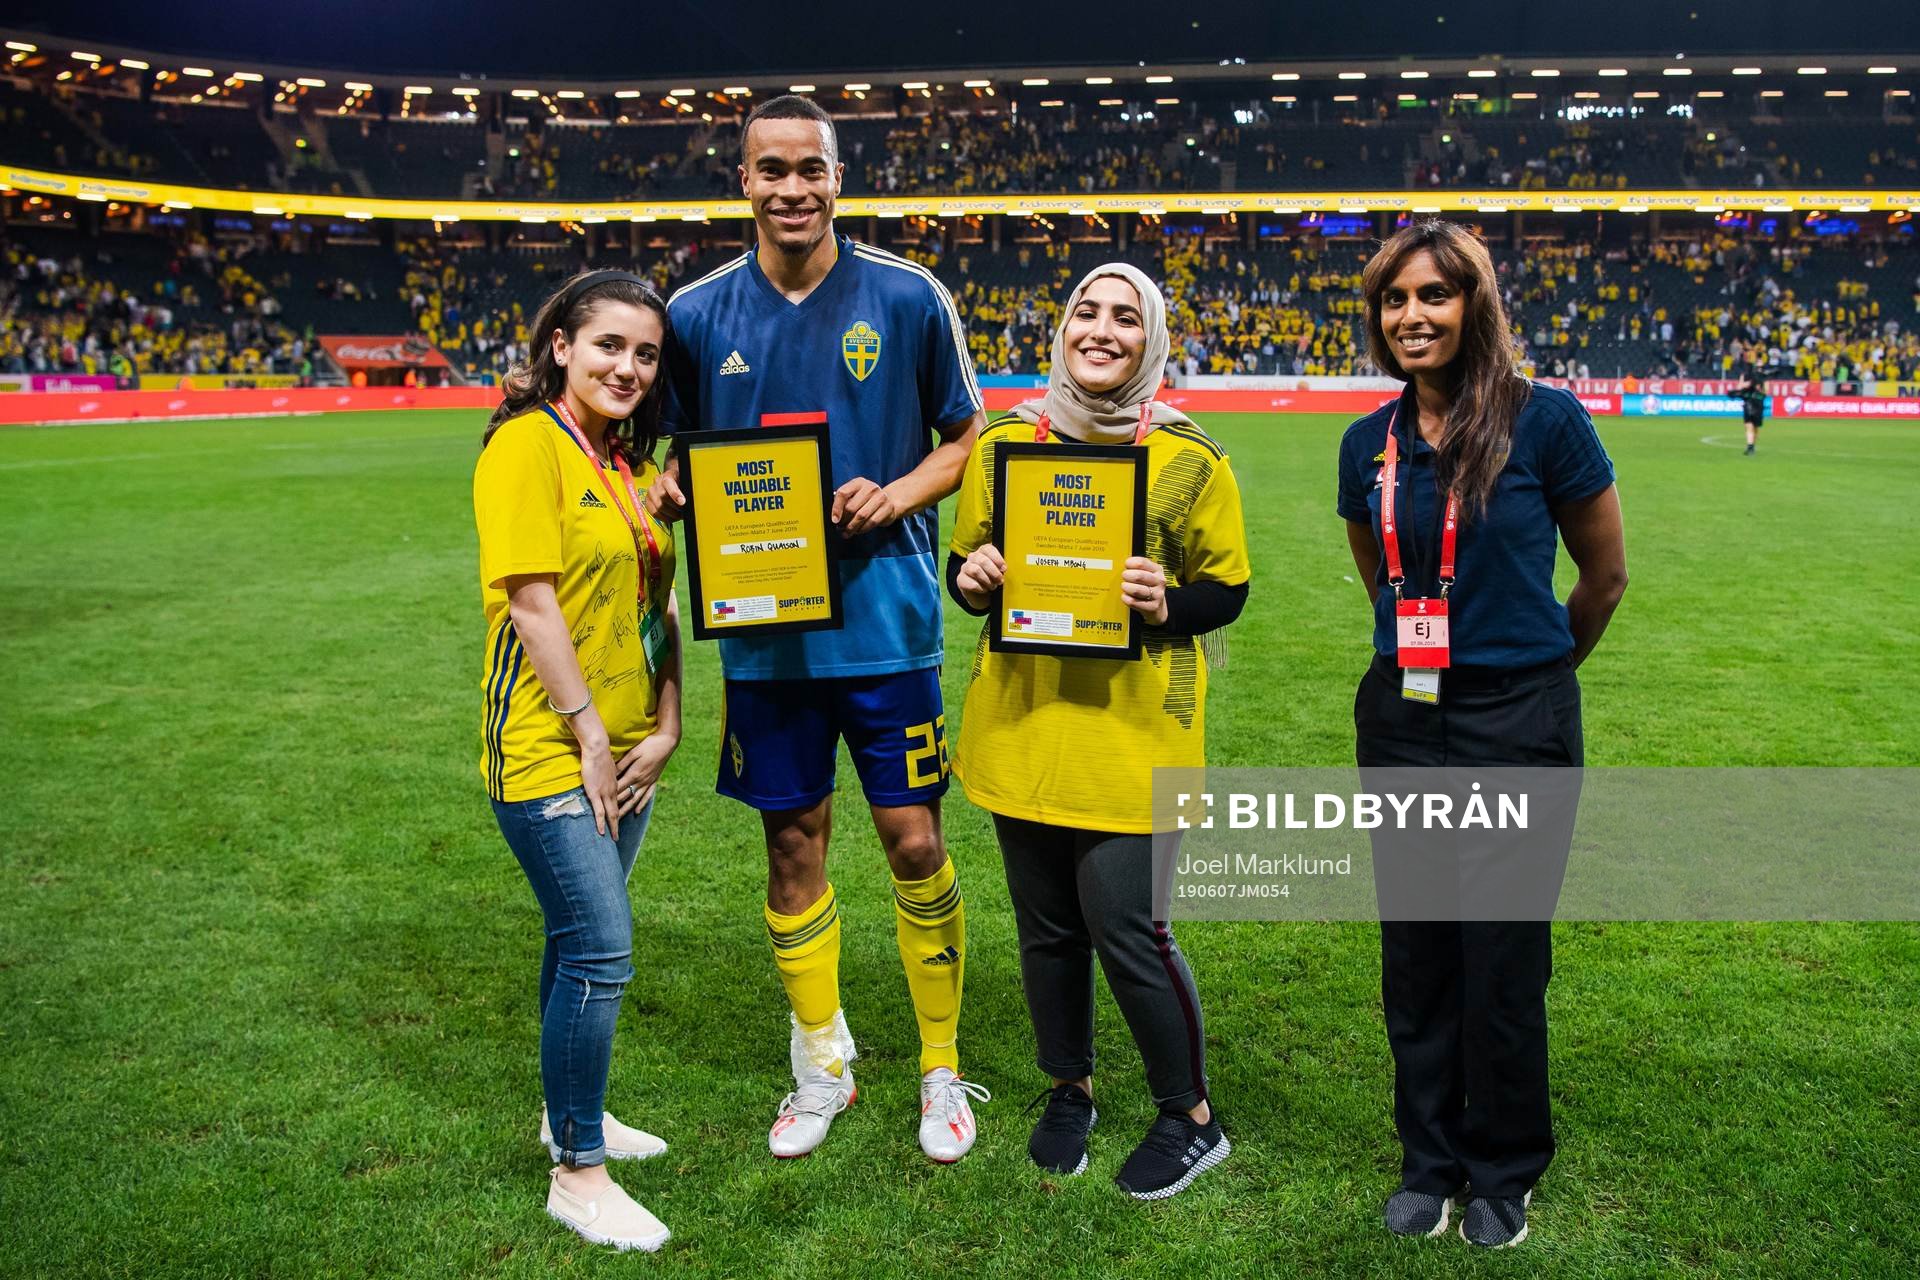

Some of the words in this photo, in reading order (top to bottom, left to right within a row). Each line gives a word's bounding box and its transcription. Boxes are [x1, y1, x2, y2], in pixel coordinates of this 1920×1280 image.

[719, 364, 750, 376] adidas
[737, 460, 774, 477] MOST
[724, 477, 791, 496] VALUABLE
[1054, 474, 1092, 490] MOST
[734, 495, 784, 513] PLAYER
[1039, 492, 1105, 509] VALUABLE
[1046, 510, 1096, 527] PLAYER
[1035, 557, 1059, 566] JOSEPH
[779, 596, 825, 608] SUPPORTER
[1075, 619, 1123, 632] SUPPORTER
[1415, 622, 1430, 639] Ej
